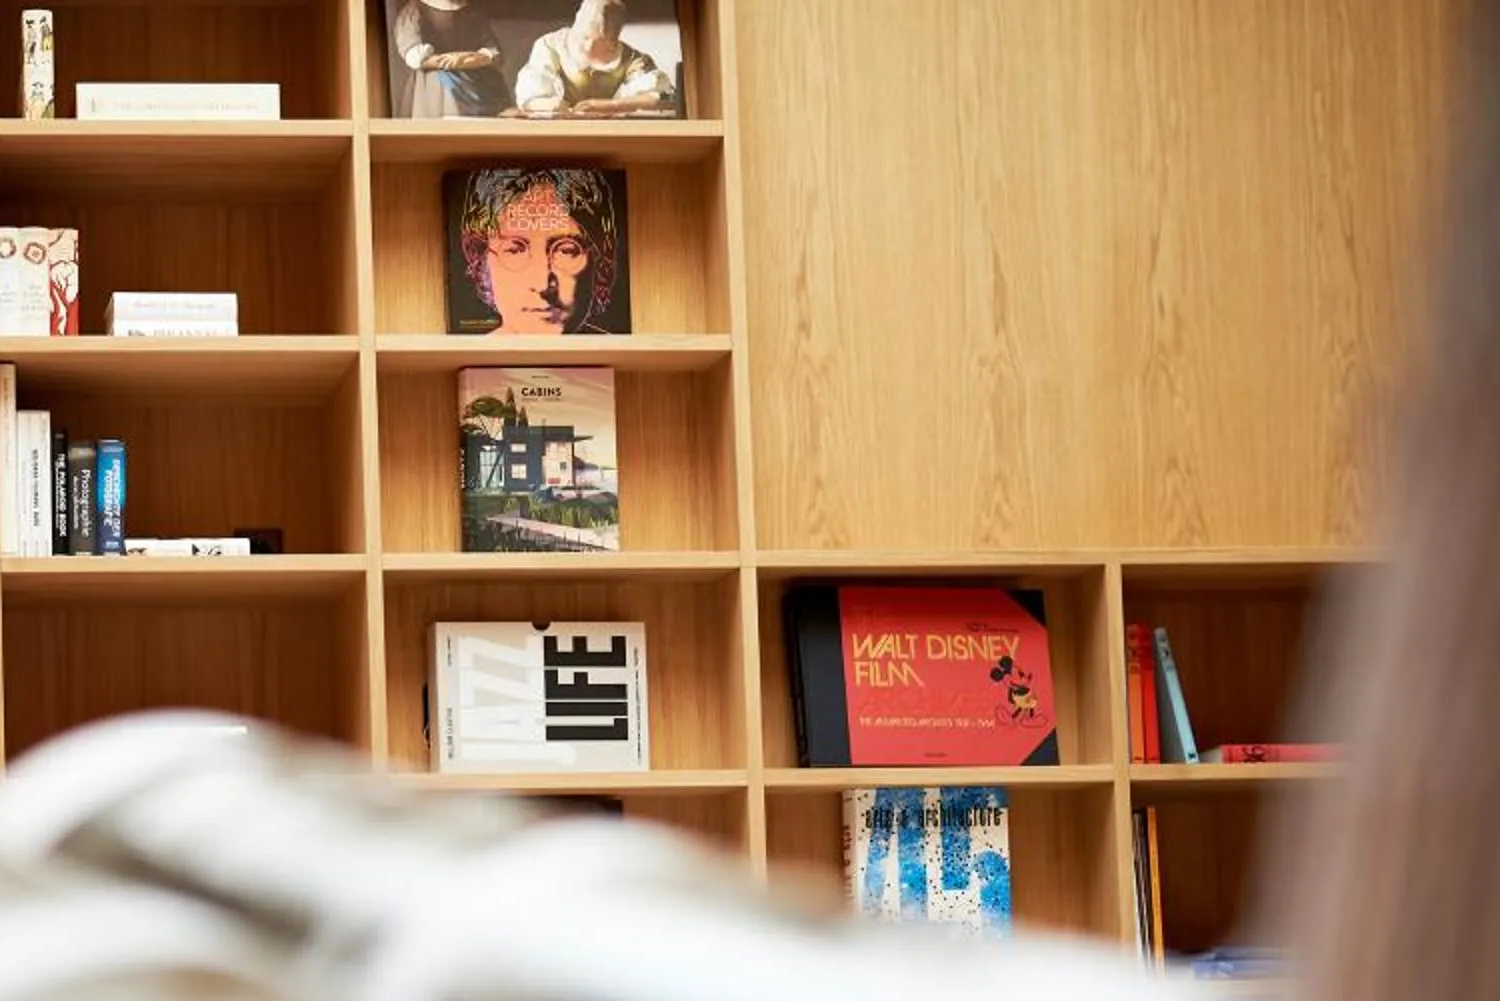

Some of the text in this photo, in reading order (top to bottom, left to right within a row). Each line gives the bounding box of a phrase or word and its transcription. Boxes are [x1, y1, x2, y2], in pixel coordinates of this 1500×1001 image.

[508, 203, 570, 217] RECORD
[508, 217, 569, 231] COVERS
[521, 387, 562, 397] CABINS
[852, 633, 1020, 661] WALT DISNEY
[854, 661, 926, 687] FILM
[543, 635, 628, 740] LIFE
